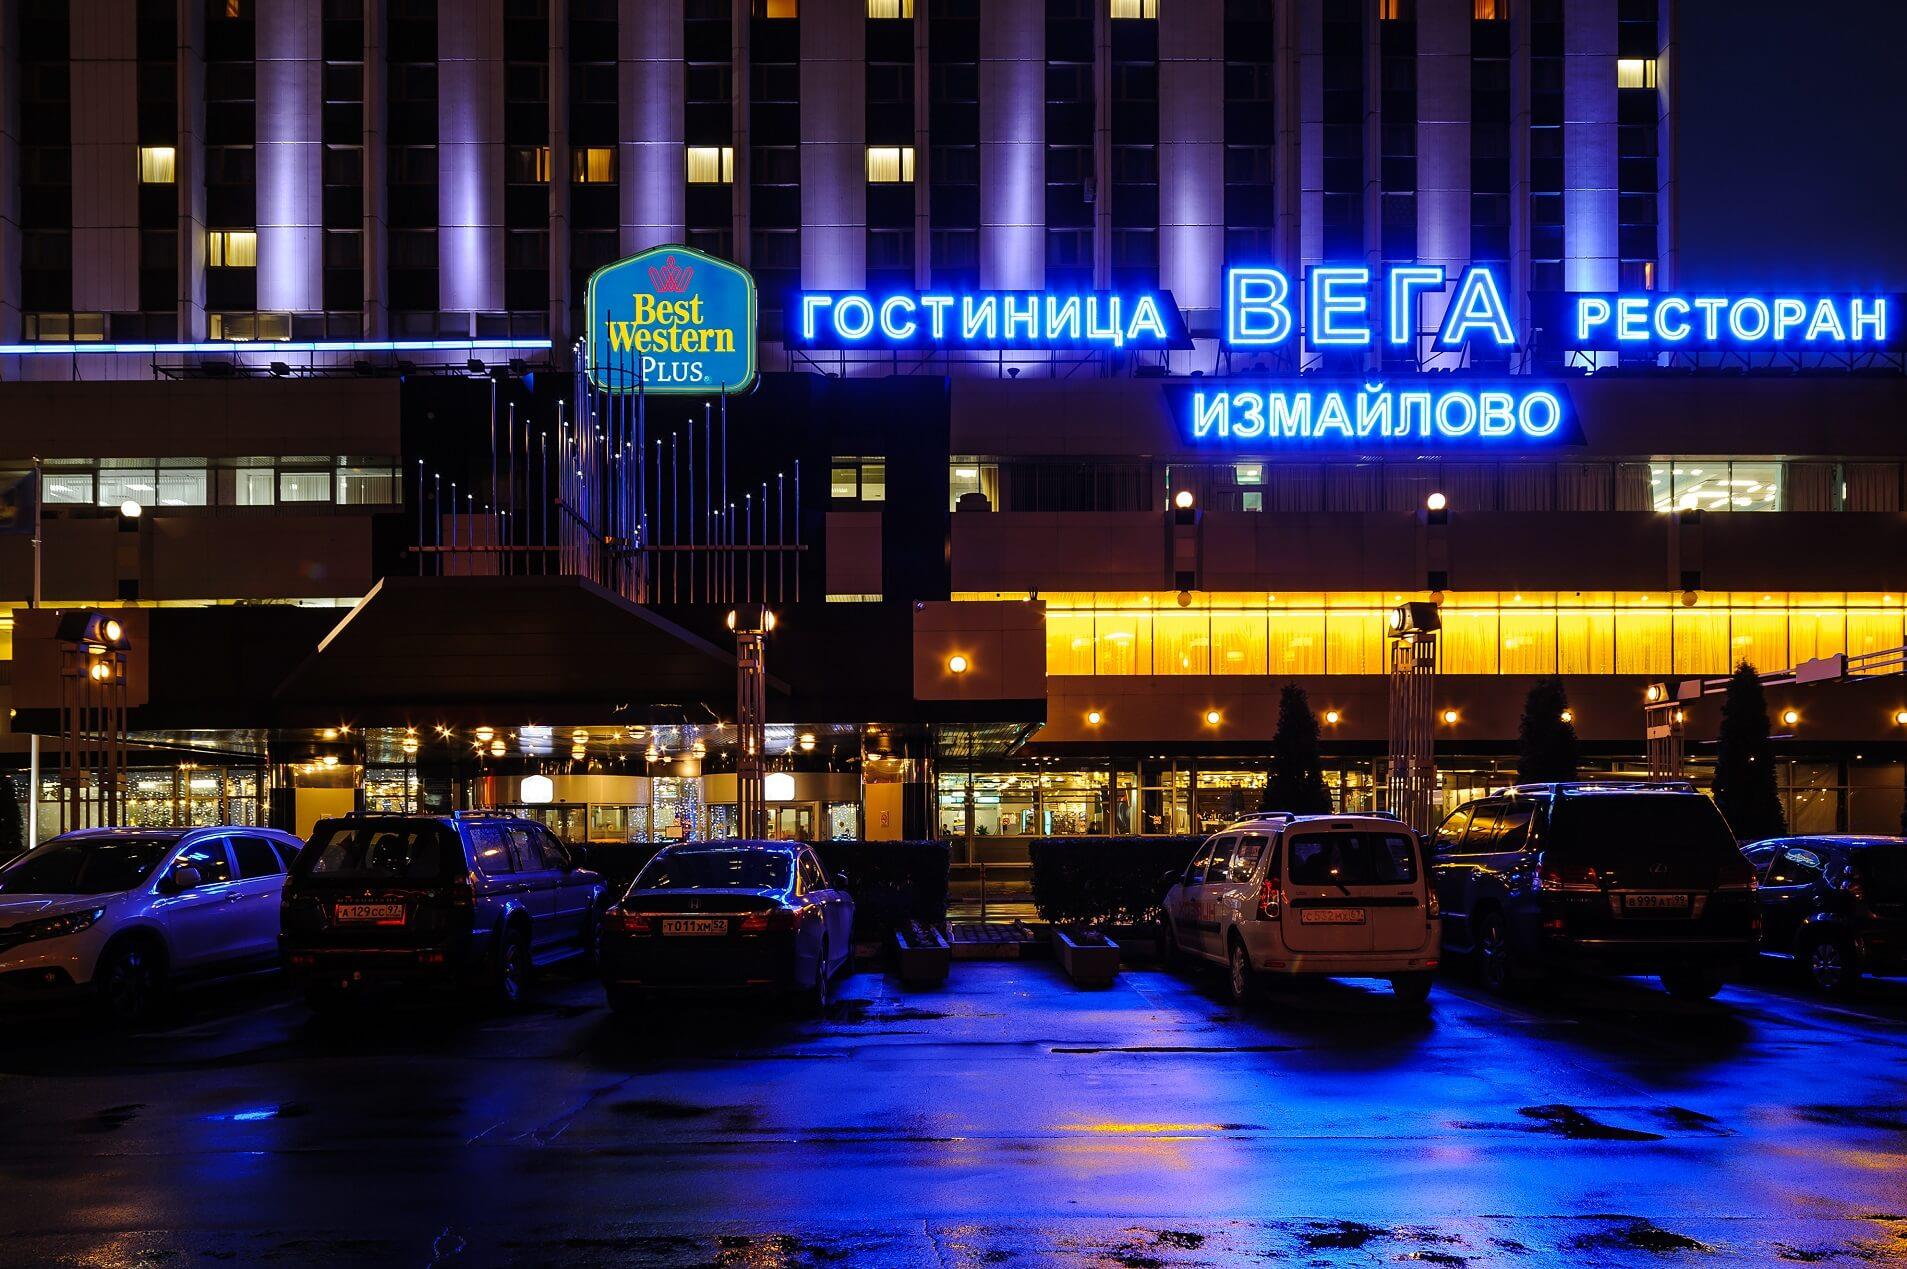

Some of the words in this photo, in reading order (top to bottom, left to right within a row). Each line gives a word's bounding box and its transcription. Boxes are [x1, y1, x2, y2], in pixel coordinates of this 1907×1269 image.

[632, 293, 704, 325] Best
[802, 295, 1168, 347] ГОСТИНИЦА
[1228, 267, 1516, 345] ВЕГА
[1577, 297, 1886, 341] РЕСТОРАН
[604, 318, 736, 353] Western
[641, 356, 703, 382] PLUS
[1193, 383, 1562, 438] ИЗМАЙЛОВО
